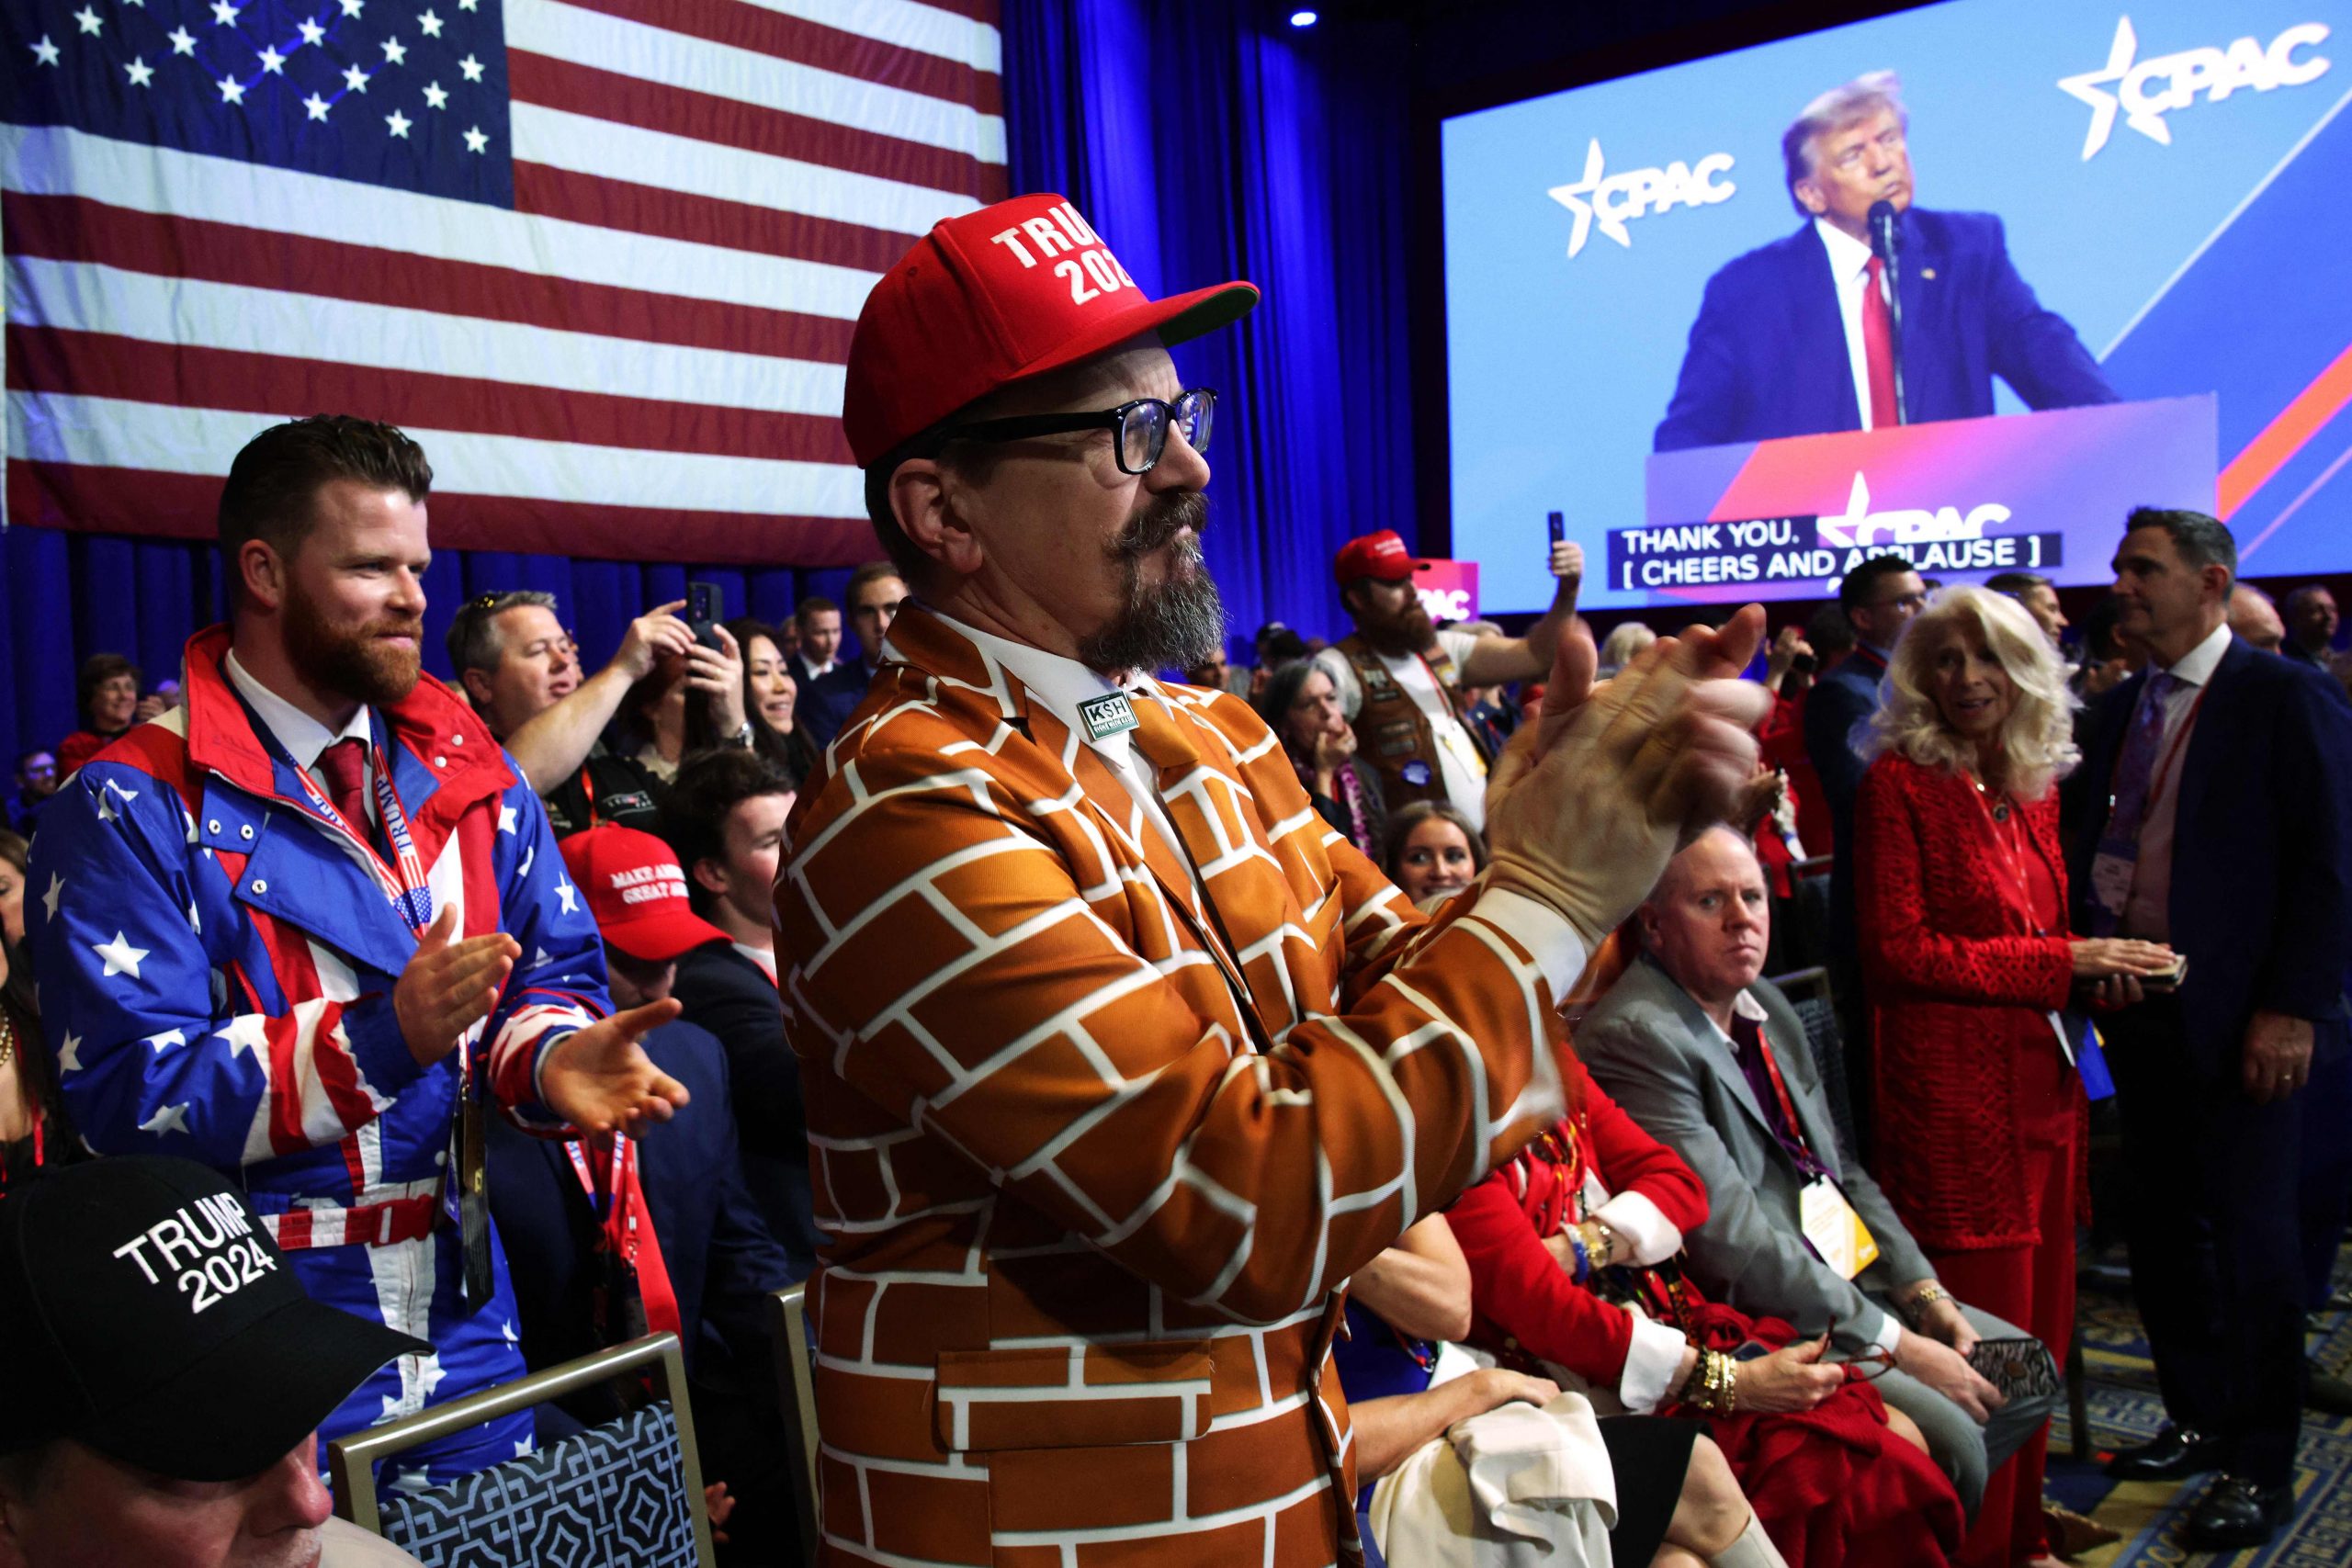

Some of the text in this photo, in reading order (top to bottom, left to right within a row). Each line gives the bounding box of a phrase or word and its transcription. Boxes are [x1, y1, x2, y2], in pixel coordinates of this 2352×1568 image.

[2118, 22, 2331, 112] CPAC
[1590, 152, 1736, 220] CPAC
[990, 202, 1107, 268] TRU
[1054, 249, 1136, 305] 202
[1621, 519, 1800, 555] THANK YOU.
[1642, 553, 1759, 585] CHEERS
[1766, 549, 1837, 579] AND
[375, 779, 413, 853] TRUMP
[112, 1192, 253, 1285] TRUMP
[177, 1236, 277, 1314] 2024
